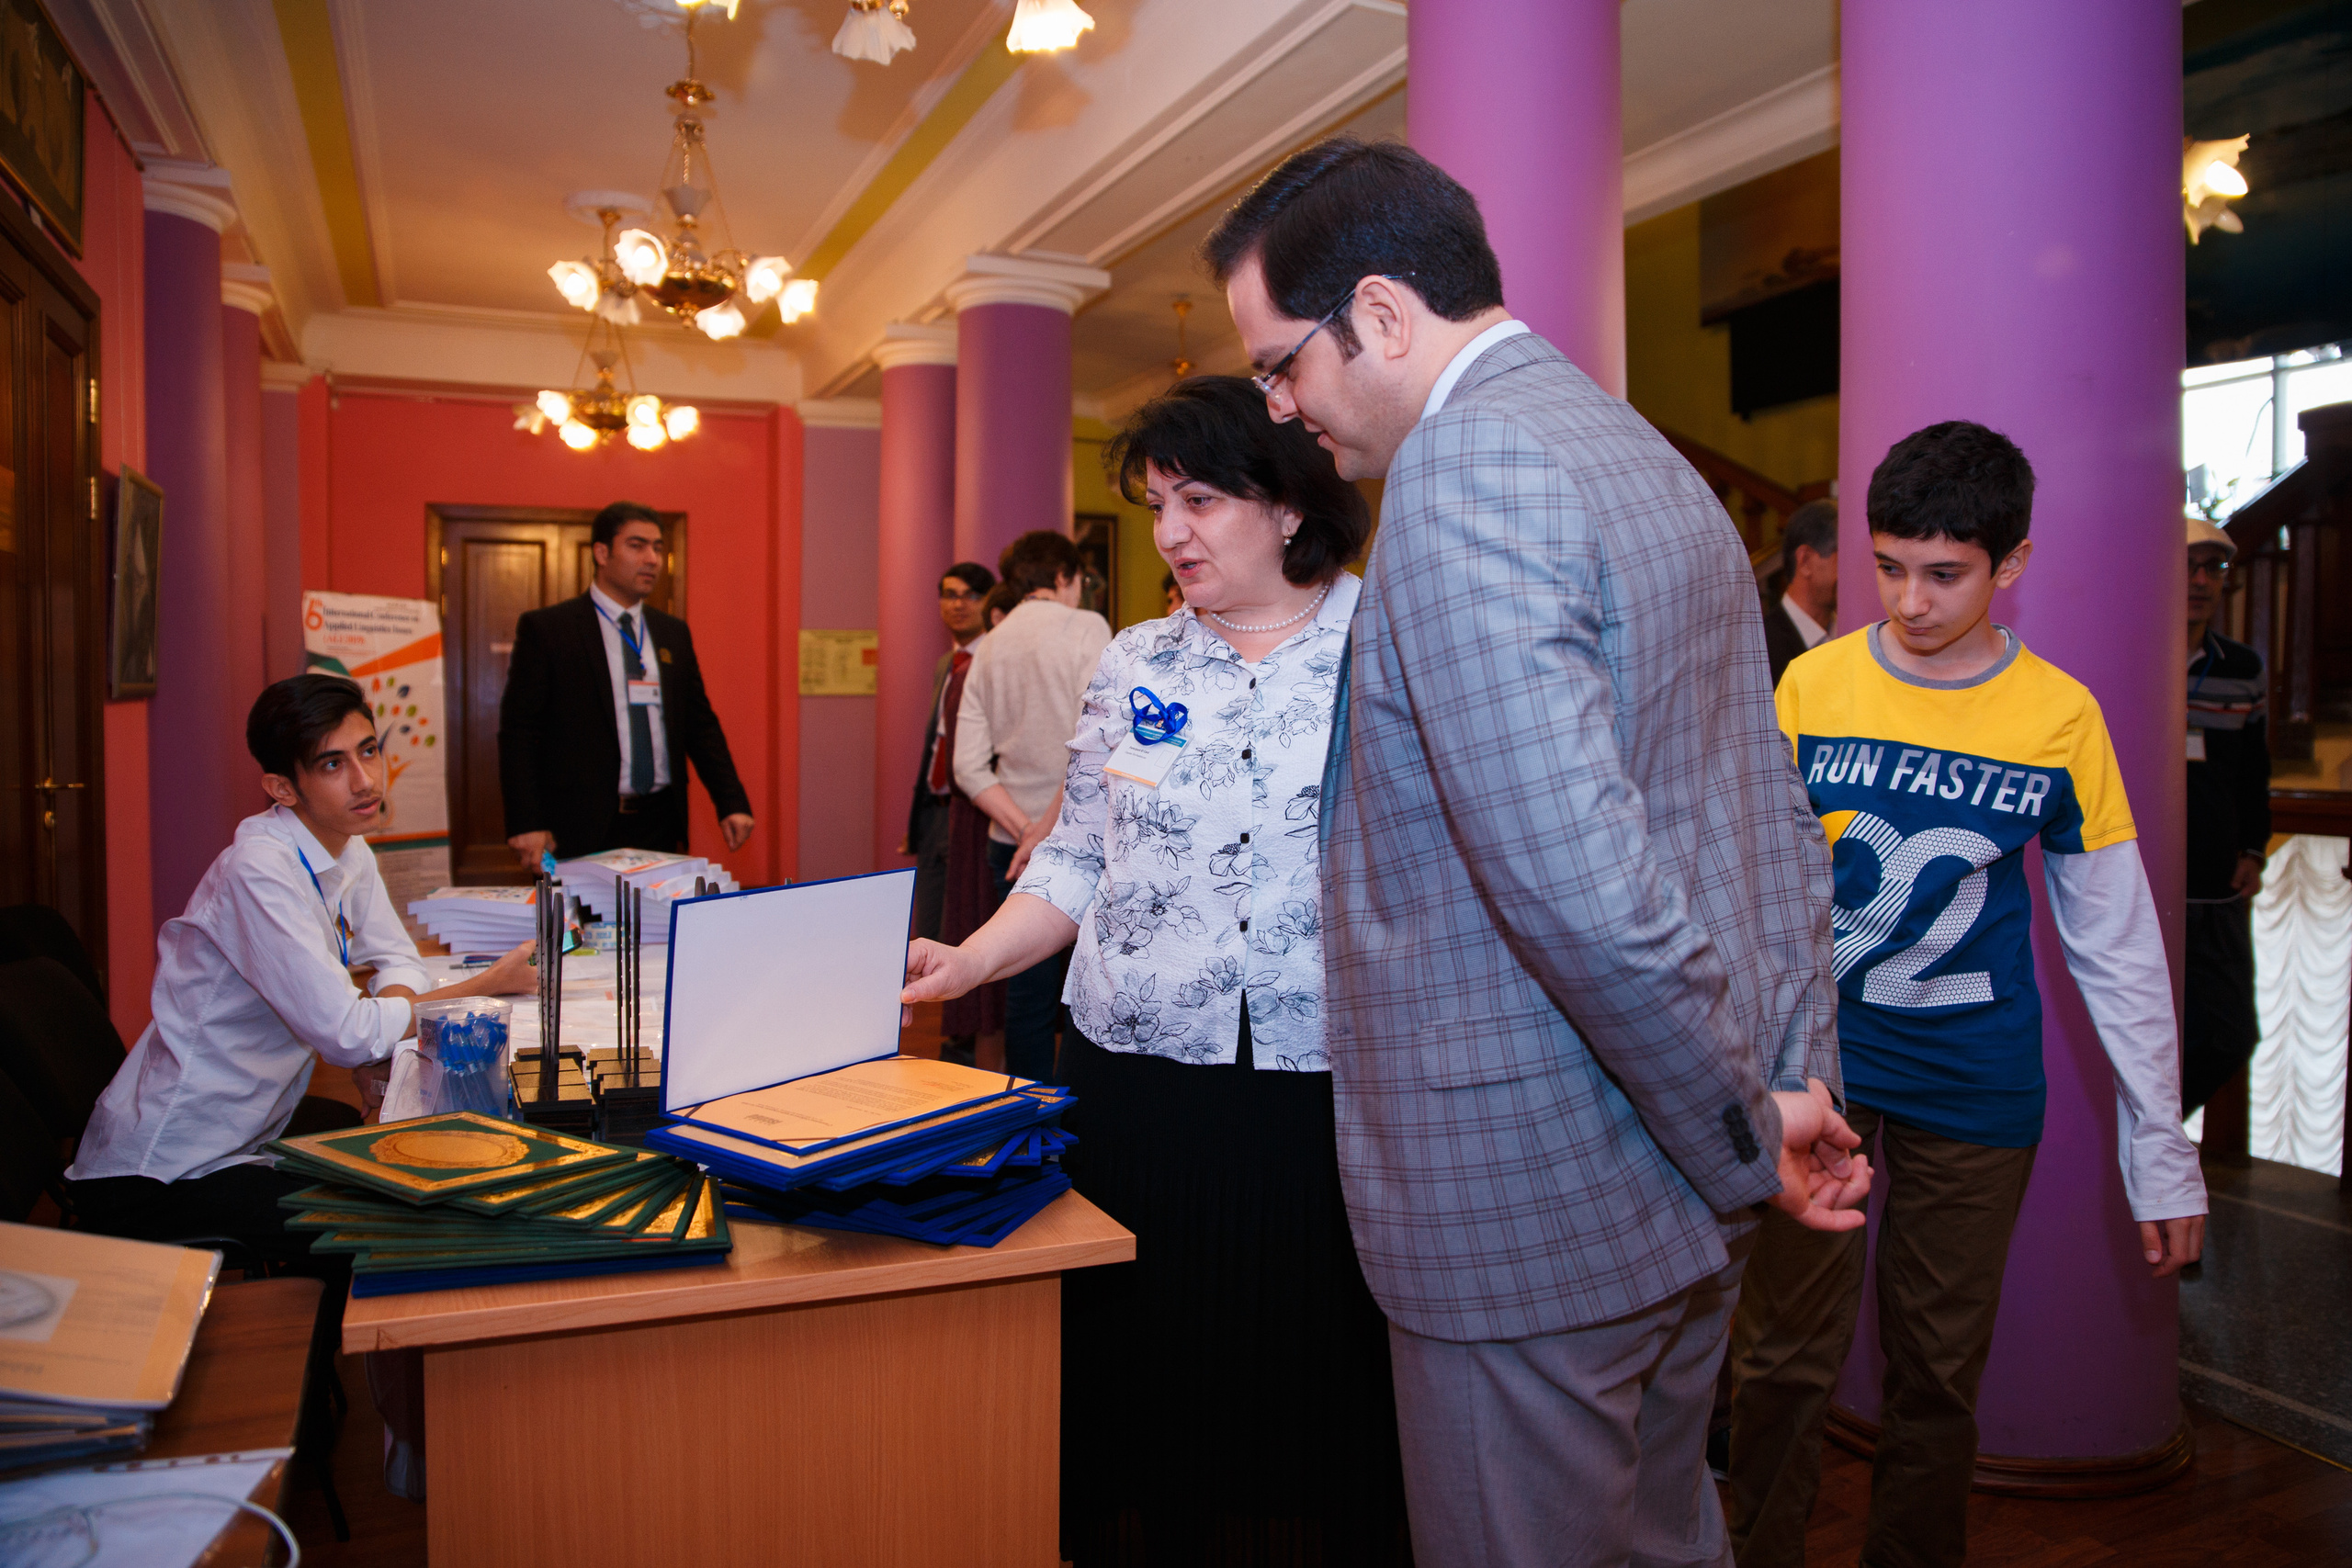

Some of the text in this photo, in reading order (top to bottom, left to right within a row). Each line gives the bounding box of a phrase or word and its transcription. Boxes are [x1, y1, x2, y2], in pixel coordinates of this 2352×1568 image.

[322, 606, 369, 618] International
[369, 611, 410, 622] Conference
[324, 621, 353, 632] Applied
[1807, 742, 2052, 817] RUN FASTER
